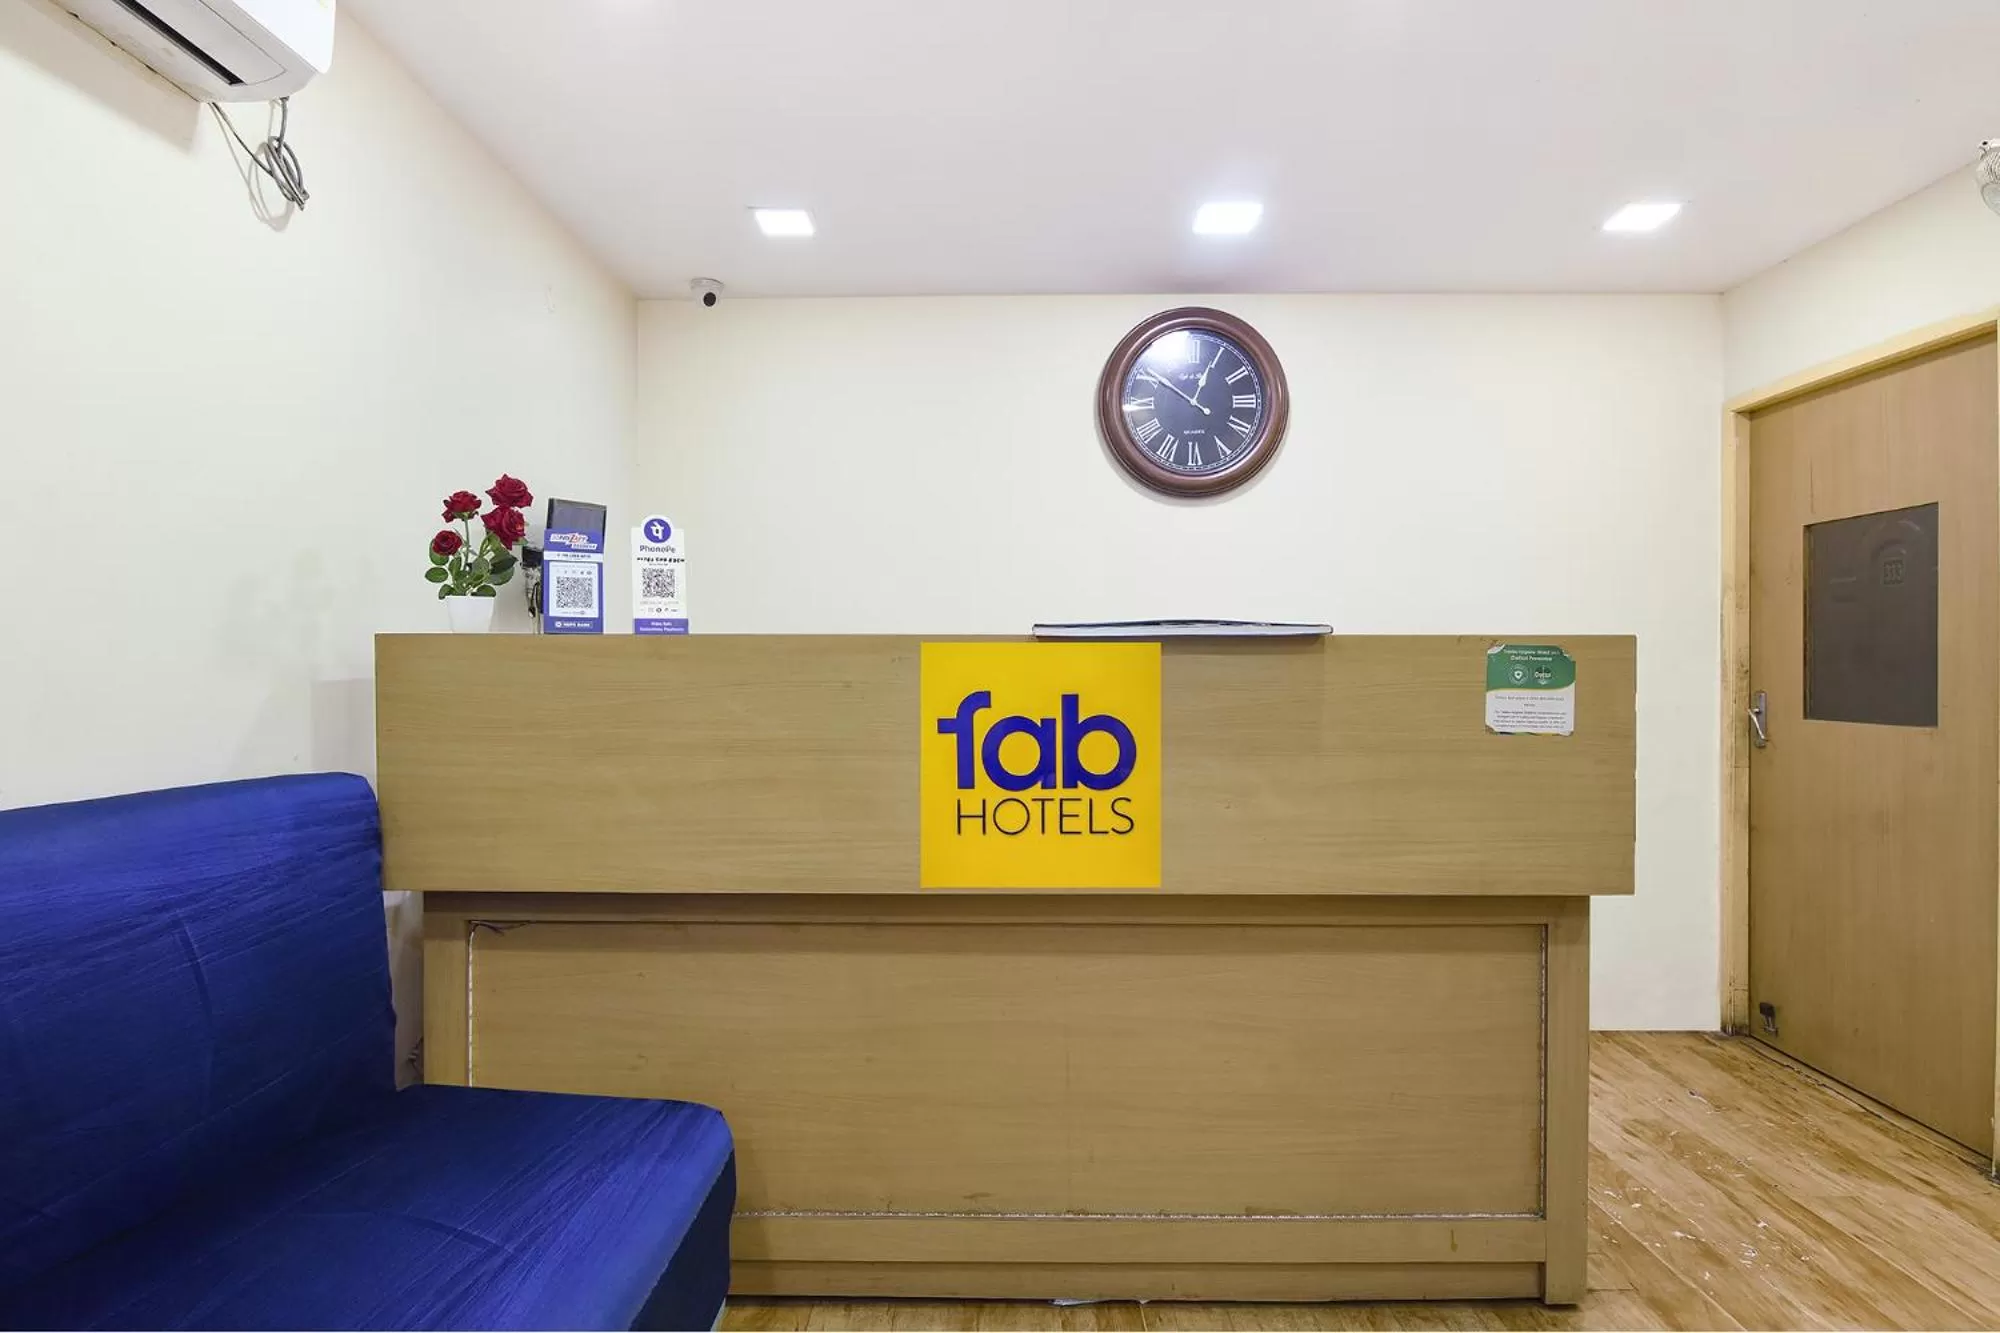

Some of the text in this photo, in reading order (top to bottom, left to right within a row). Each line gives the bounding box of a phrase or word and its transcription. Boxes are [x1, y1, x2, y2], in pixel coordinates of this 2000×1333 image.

[639, 545, 676, 554] PhonePe
[937, 691, 1136, 793] fab
[957, 797, 1134, 836] HOTELS
